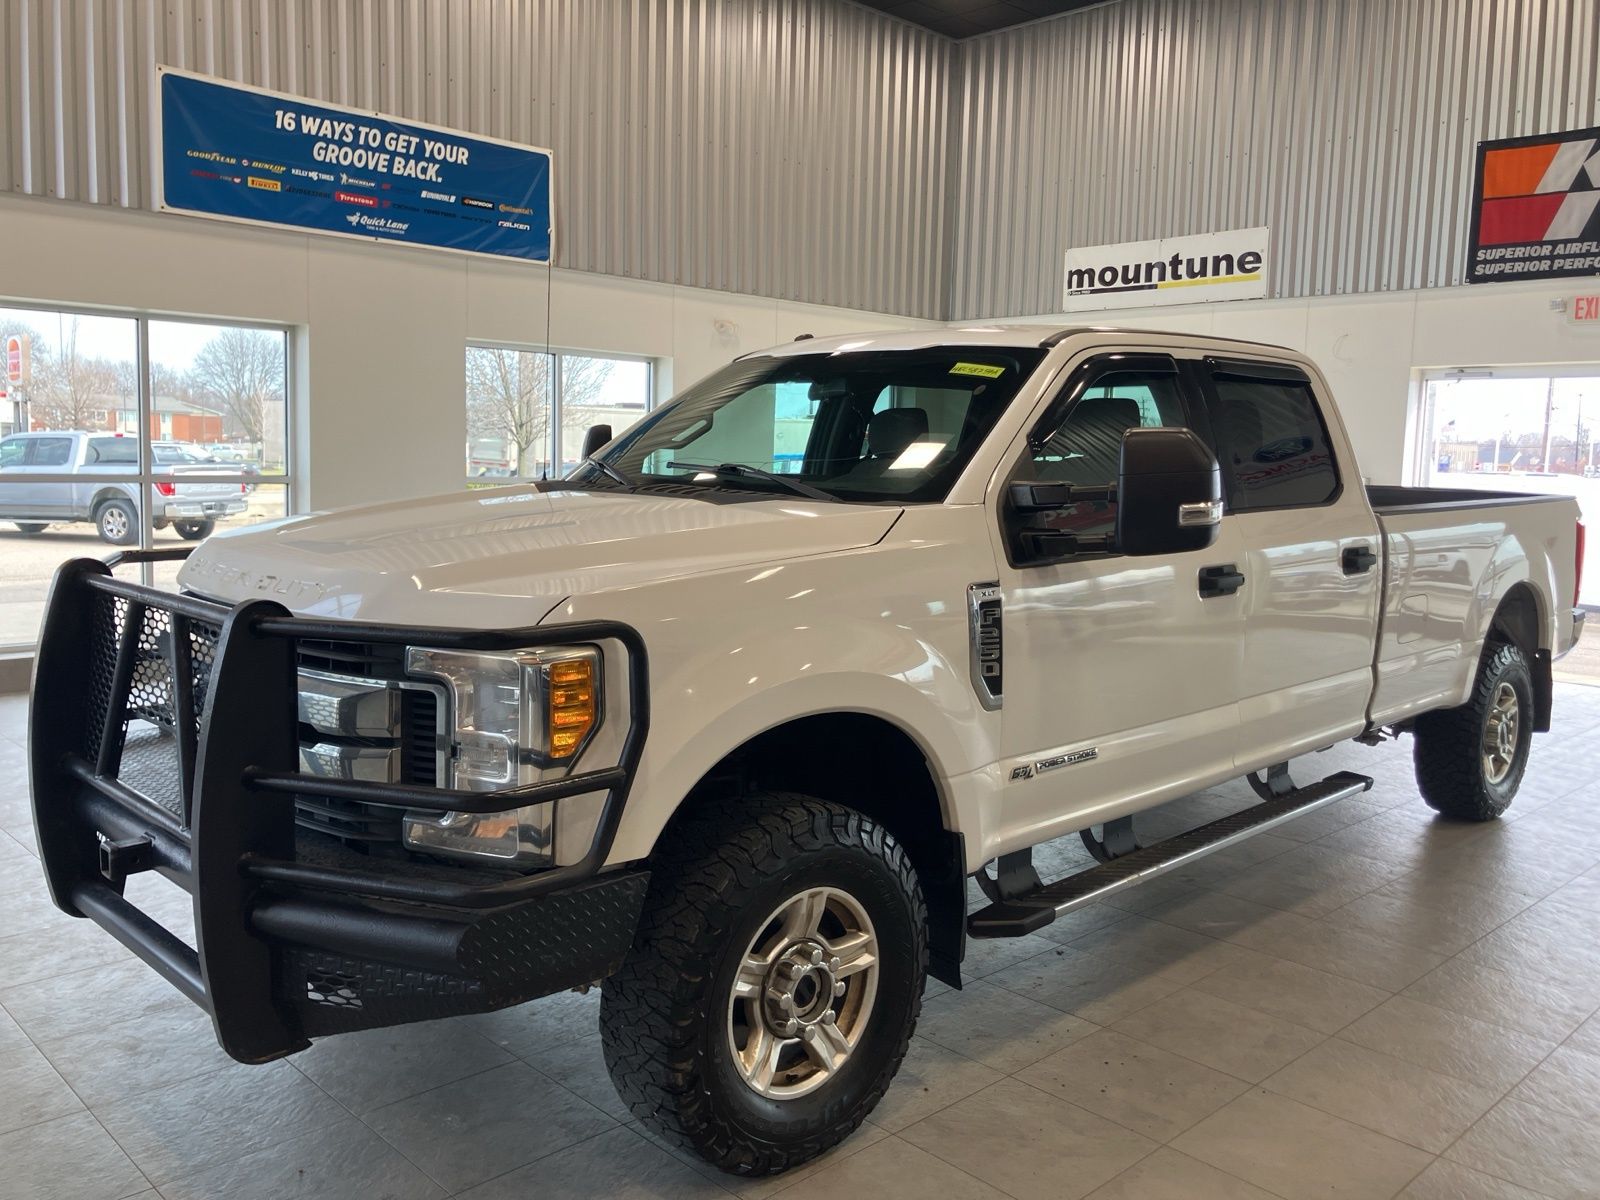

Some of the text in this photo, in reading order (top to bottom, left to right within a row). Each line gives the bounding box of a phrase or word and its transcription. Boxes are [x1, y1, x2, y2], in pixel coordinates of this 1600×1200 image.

[275, 110, 469, 165] 16 WAYS TO GET YOUR
[187, 150, 237, 164] GOODYEAR
[312, 141, 443, 183] GROOVE BACK.
[251, 161, 287, 172] DUNLOP
[360, 215, 410, 231] Quick Lane
[498, 220, 531, 231] FALKEN
[1476, 241, 1600, 261] SUPERIOR AIRFL
[1068, 251, 1262, 289] mountune
[1475, 260, 1551, 275] SUPERIOR
[1066, 748, 1097, 763] STROKE
